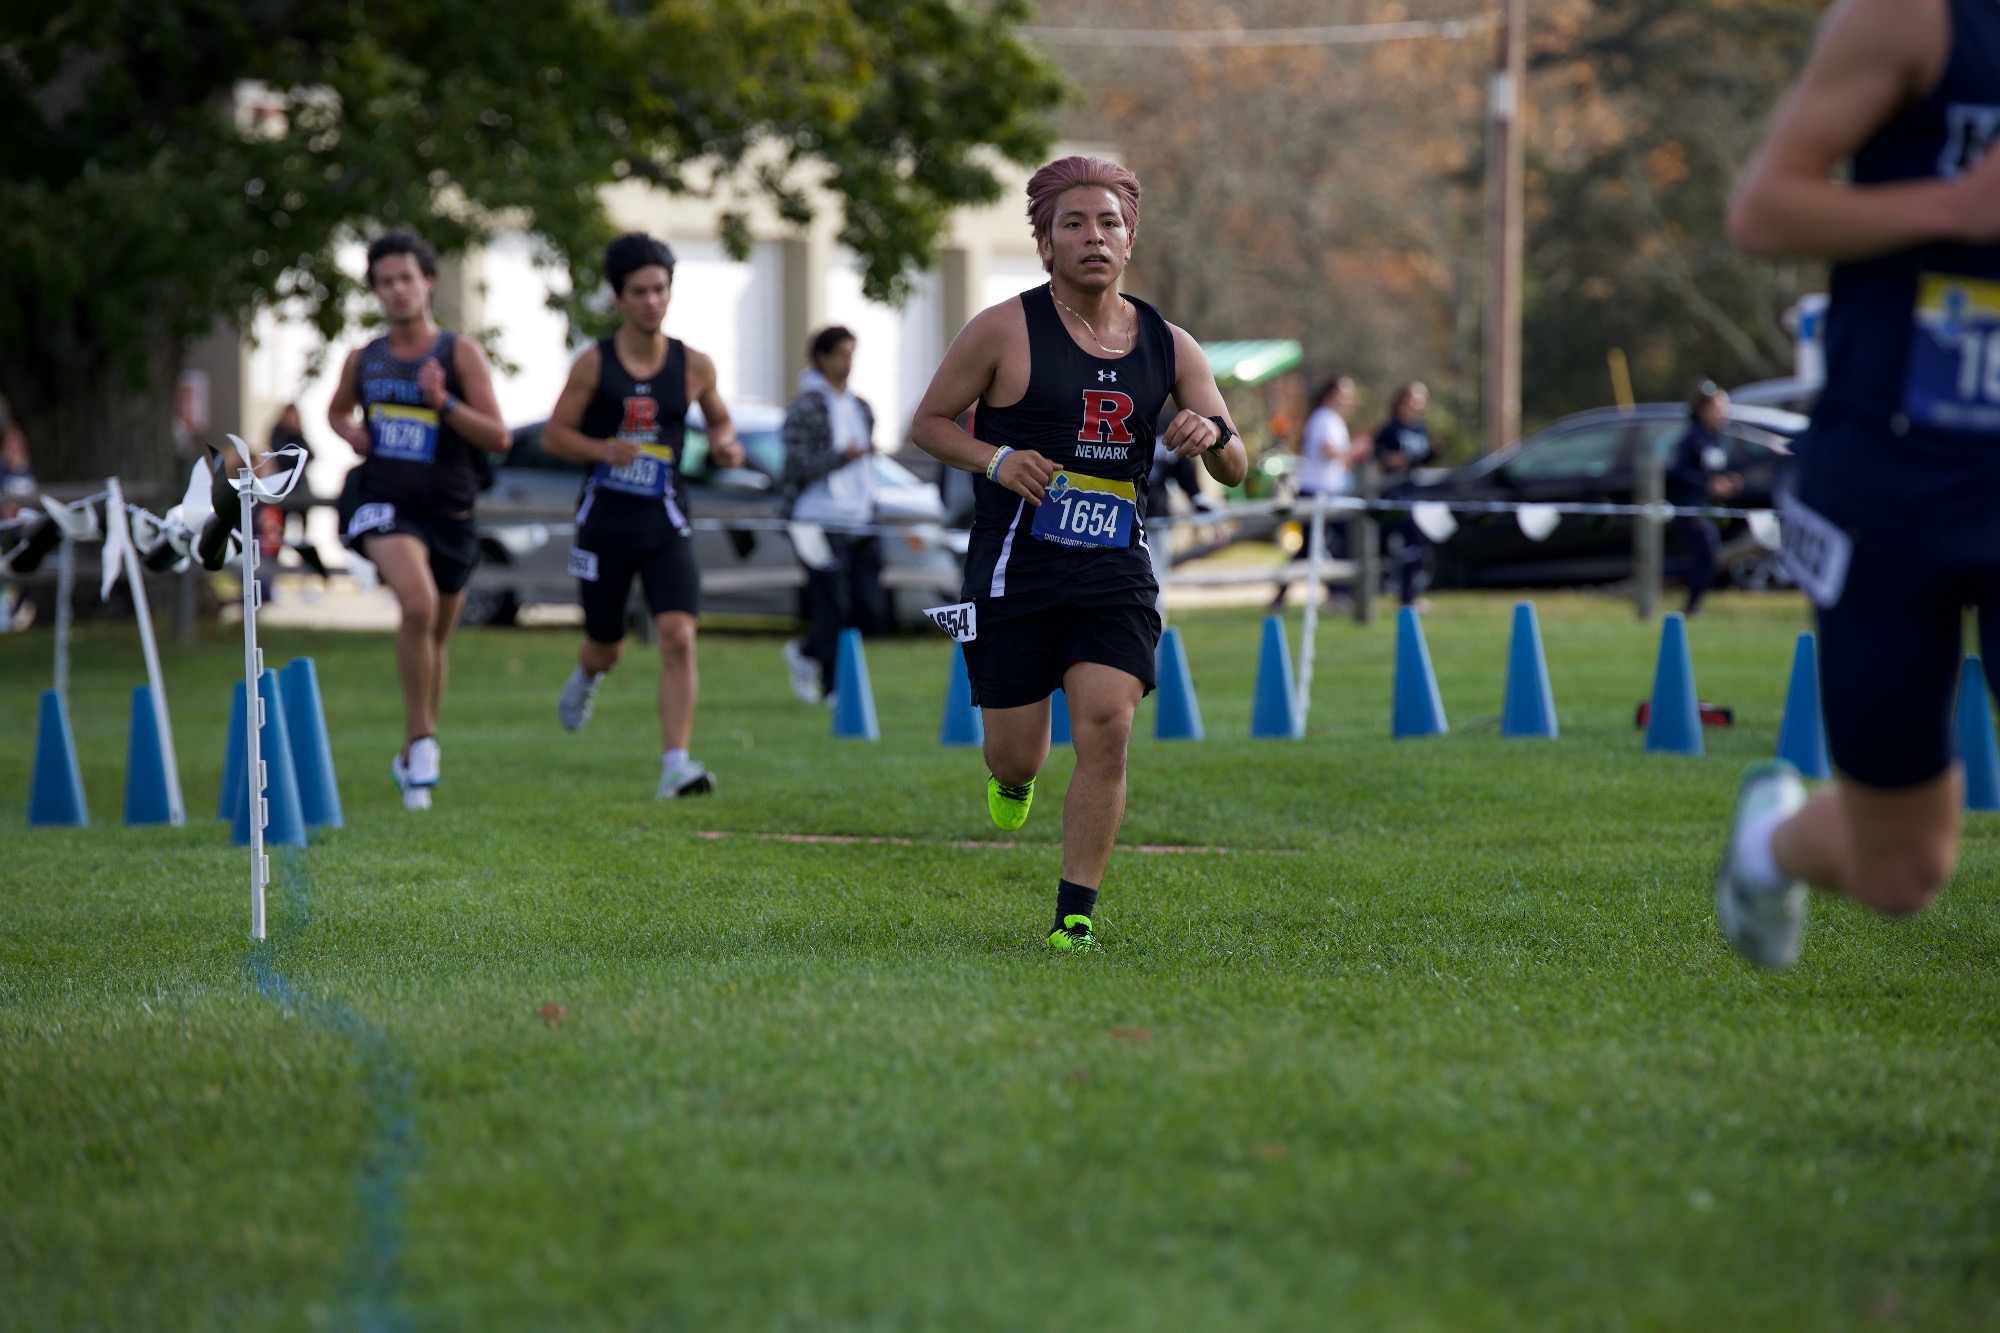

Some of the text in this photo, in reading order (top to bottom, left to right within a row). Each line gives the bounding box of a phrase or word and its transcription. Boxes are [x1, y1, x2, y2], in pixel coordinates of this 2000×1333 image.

[619, 396, 662, 432] R
[1078, 389, 1133, 443] R
[380, 420, 426, 450] 1679
[1075, 445, 1129, 459] NEWARK
[1059, 498, 1119, 538] 1654
